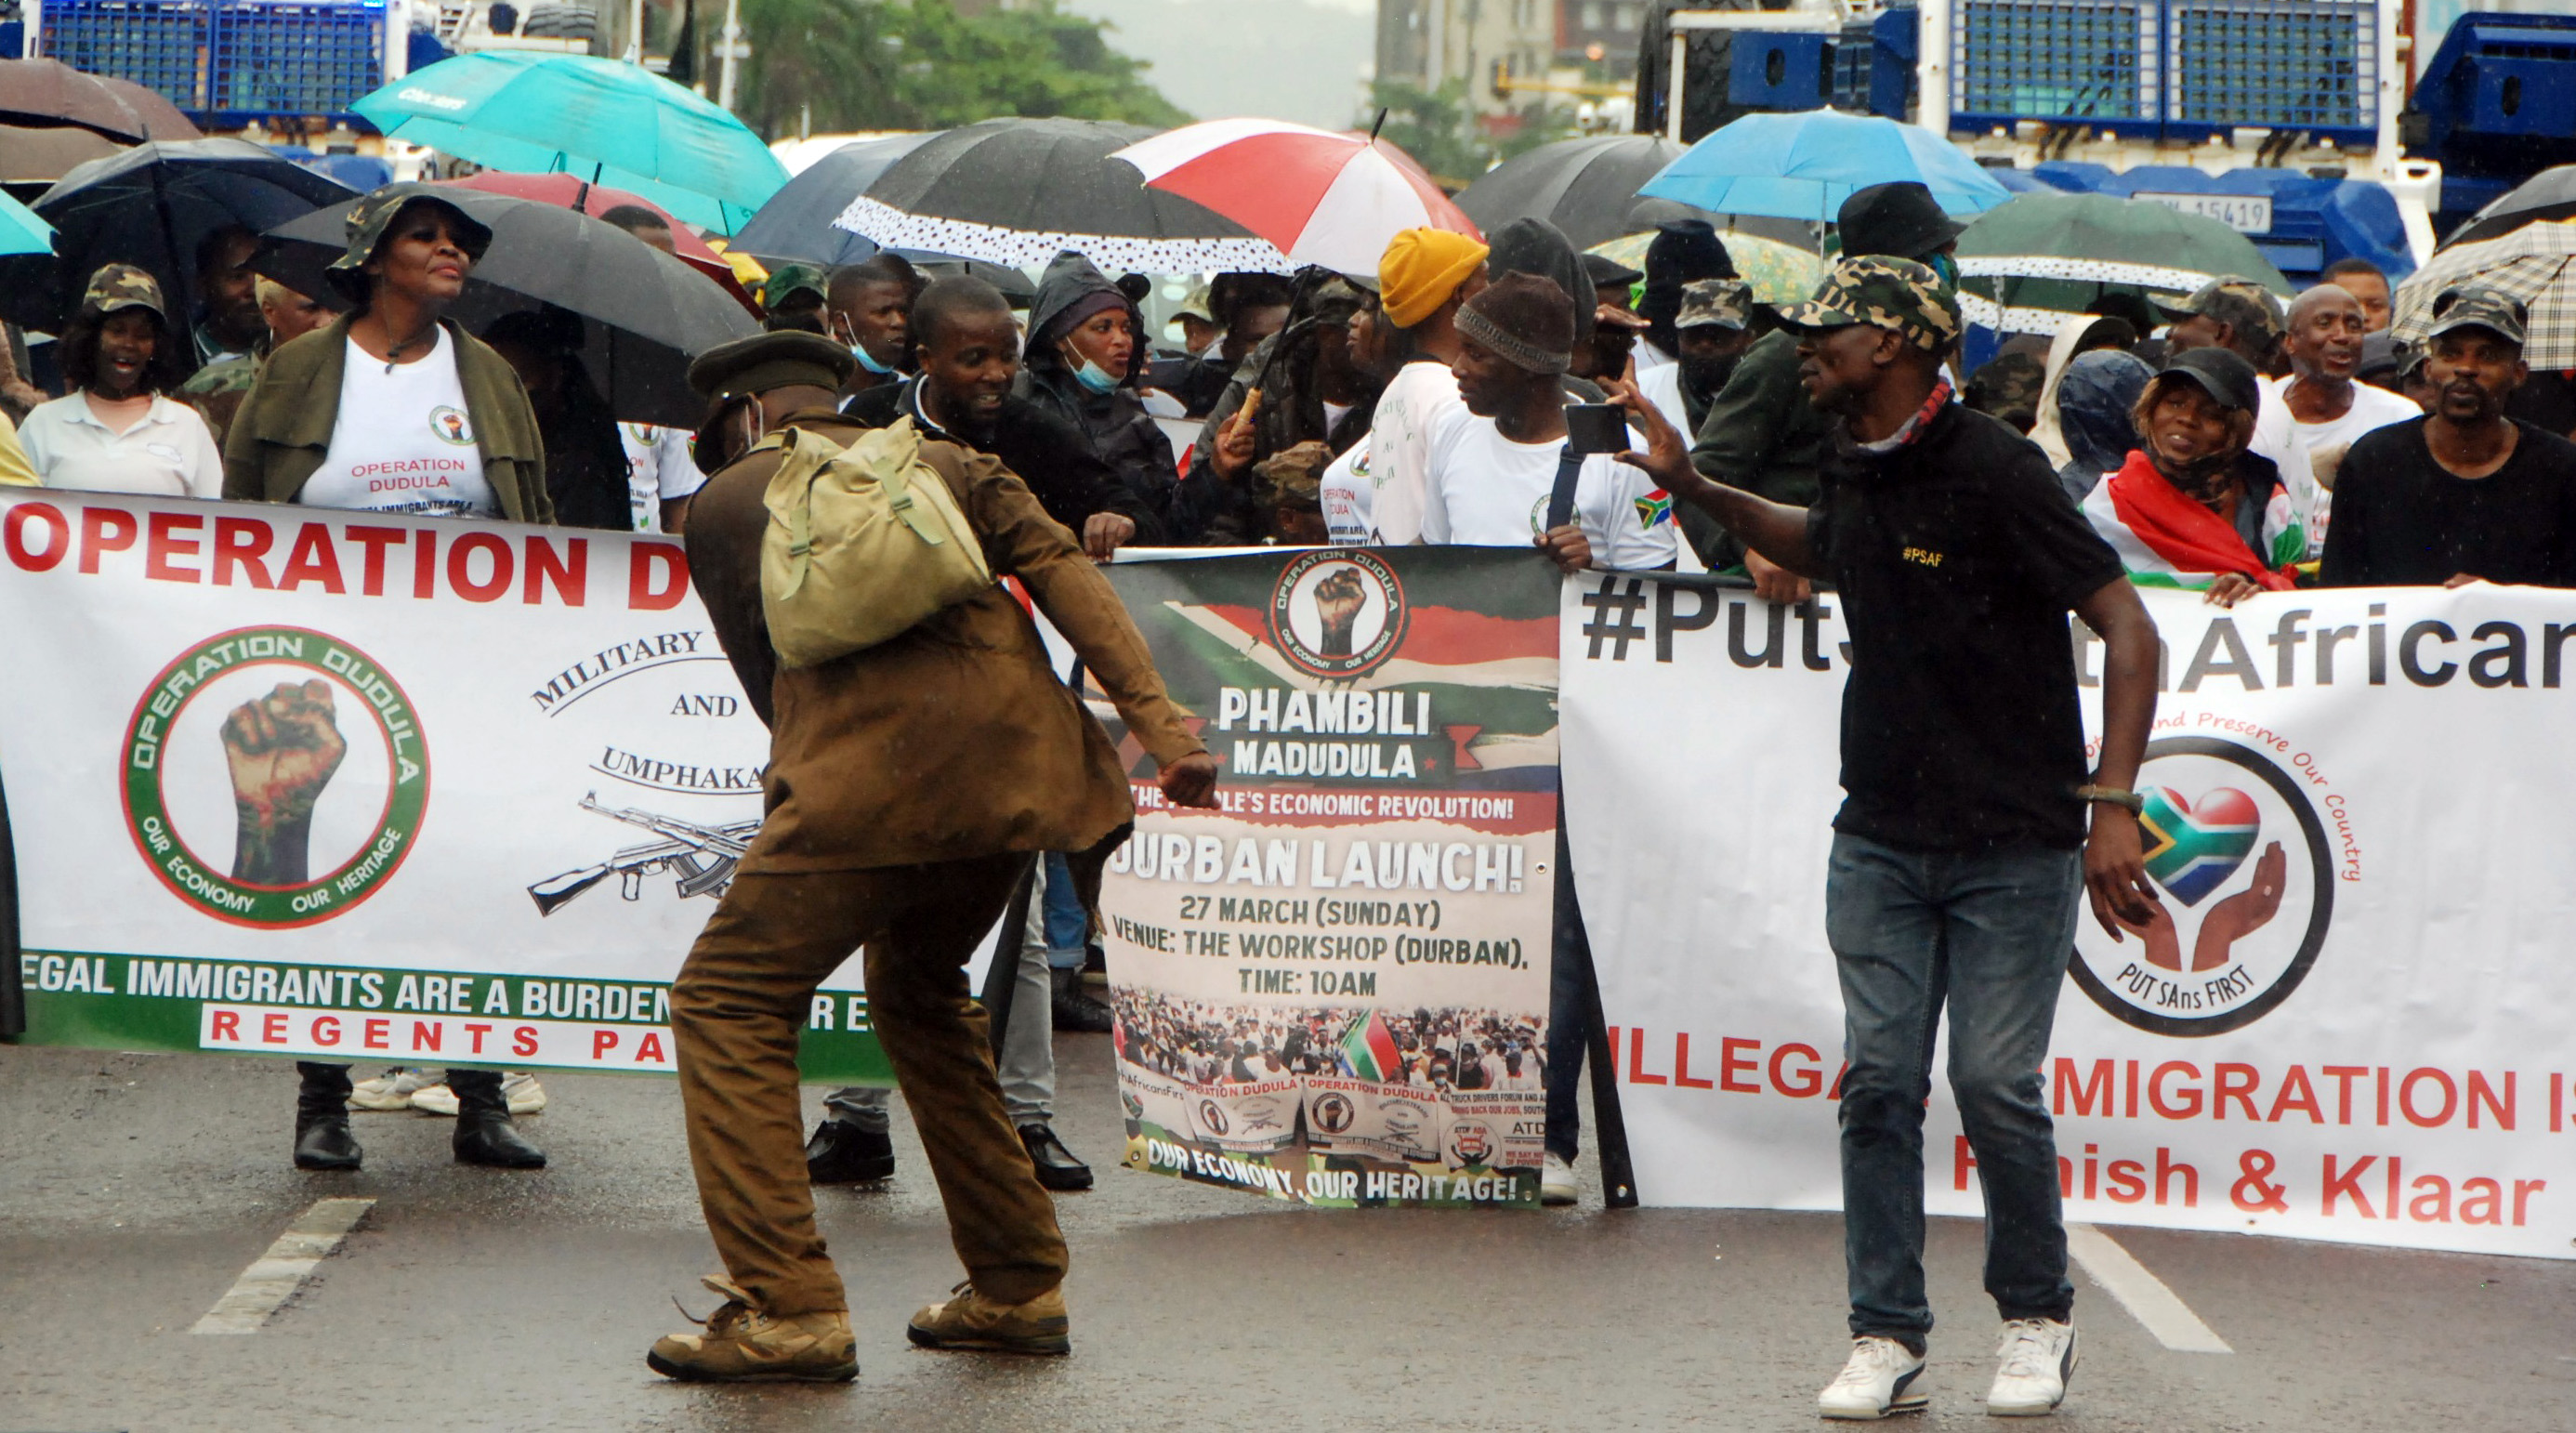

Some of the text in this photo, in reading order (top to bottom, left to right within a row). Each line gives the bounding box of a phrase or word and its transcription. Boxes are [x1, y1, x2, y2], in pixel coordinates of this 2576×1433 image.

[351, 458, 466, 478] OPERATION
[370, 475, 450, 493] DUDULA
[3, 502, 588, 608] OPERATION
[1902, 546, 1943, 568] #PSAF
[1277, 550, 1399, 612] OPERATION DUDULA
[530, 630, 703, 713] MILITARY
[1281, 628, 1332, 669] OUR ECONOMY
[1345, 630, 1392, 669] OUR HERITAGE
[133, 635, 419, 785] OPERATION DUDULA
[669, 693, 739, 717] AND
[1218, 686, 1431, 736] PHAMBILI
[602, 745, 768, 790] UMPHAKA
[1233, 739, 1417, 779] MADUDULA
[1129, 784, 1164, 809] THE
[1269, 794, 1376, 817] ECONOMIC
[1378, 795, 1514, 821] REVOLUTION!
[2150, 711, 2361, 883] nd Preserve Our Country
[143, 816, 256, 914] OUR ECONOMY
[291, 827, 402, 914] OUR HERITAGE
[1309, 837, 1525, 894] LAUNCH!
[1179, 895, 1441, 930] 27 MARCH (SUNDAY)
[1111, 914, 1529, 970] VENUE: THE WORKSHOP (DURBAN).
[21, 953, 115, 994] EGAL
[126, 959, 385, 1009] IMMIGRANTS
[393, 974, 474, 1013] ARE
[482, 979, 510, 1015] A
[1238, 967, 1377, 997] TIME: 10AM
[2116, 962, 2255, 1010] PUT SAns FIRST
[211, 1009, 665, 1063] REGENTS PA
[1242, 1078, 1298, 1097] DUDULA
[1308, 1078, 1438, 1103] OPERATION DUDULA
[1473, 1093, 1499, 1103] DRIVERS
[1500, 1093, 1522, 1103] FORUM
[1512, 1122, 1545, 1135] ATD
[1148, 1137, 1189, 1171] OUR
[1306, 1170, 1359, 1199] OUR
[2230, 1148, 2290, 1216] &
[2320, 1153, 2548, 1228] Klaar
